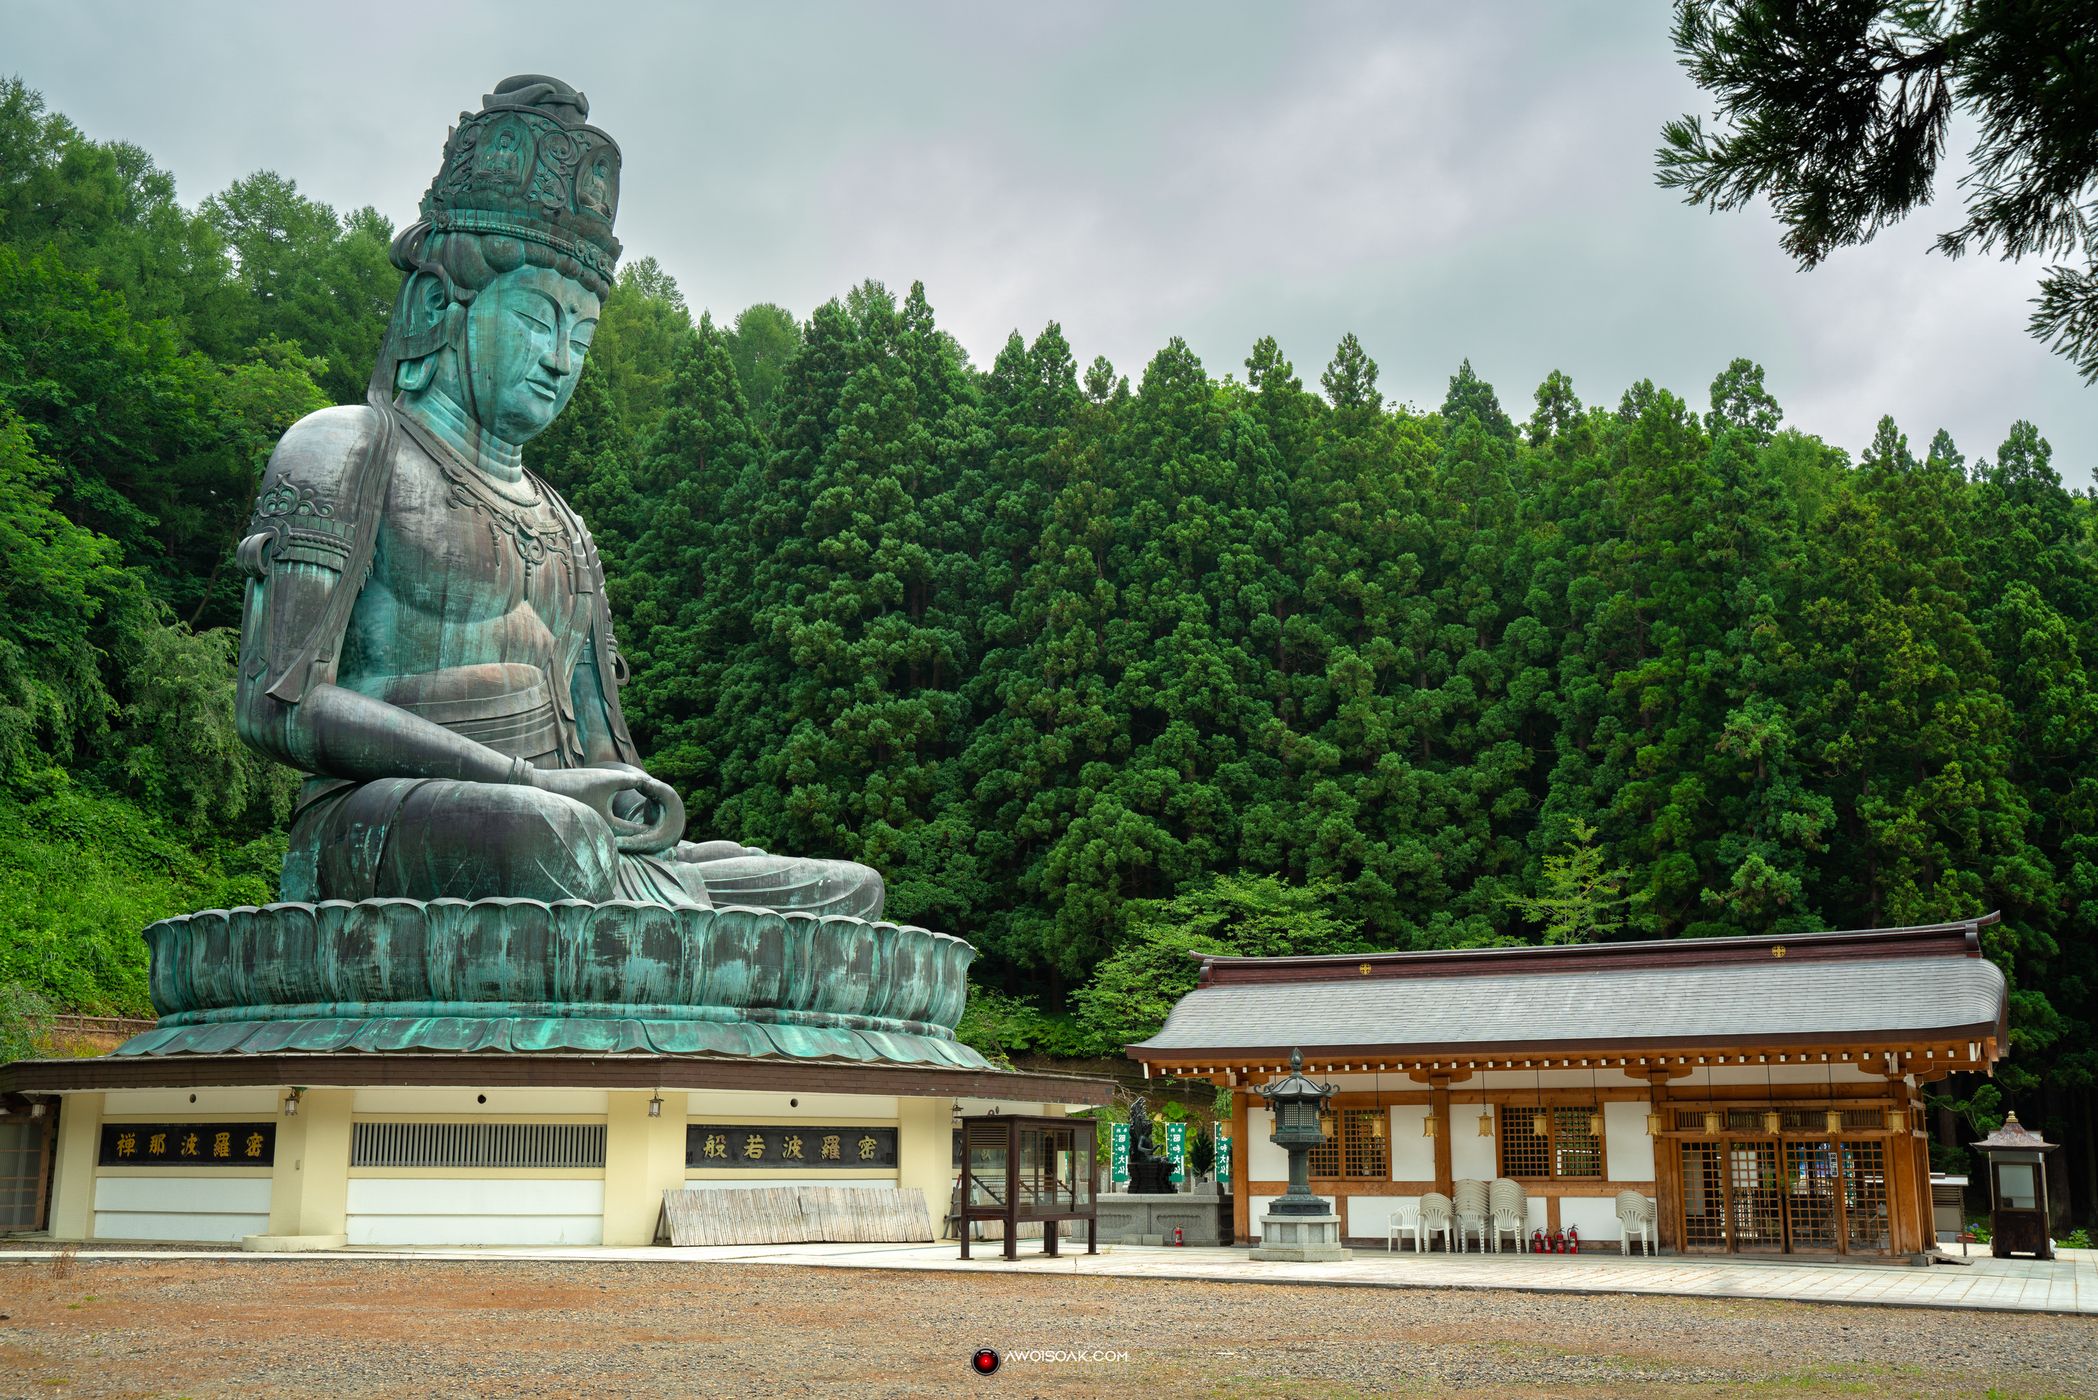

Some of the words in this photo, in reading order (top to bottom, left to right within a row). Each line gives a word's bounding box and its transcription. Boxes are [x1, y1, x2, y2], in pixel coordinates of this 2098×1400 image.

[702, 1134, 878, 1160] 般若波羅密
